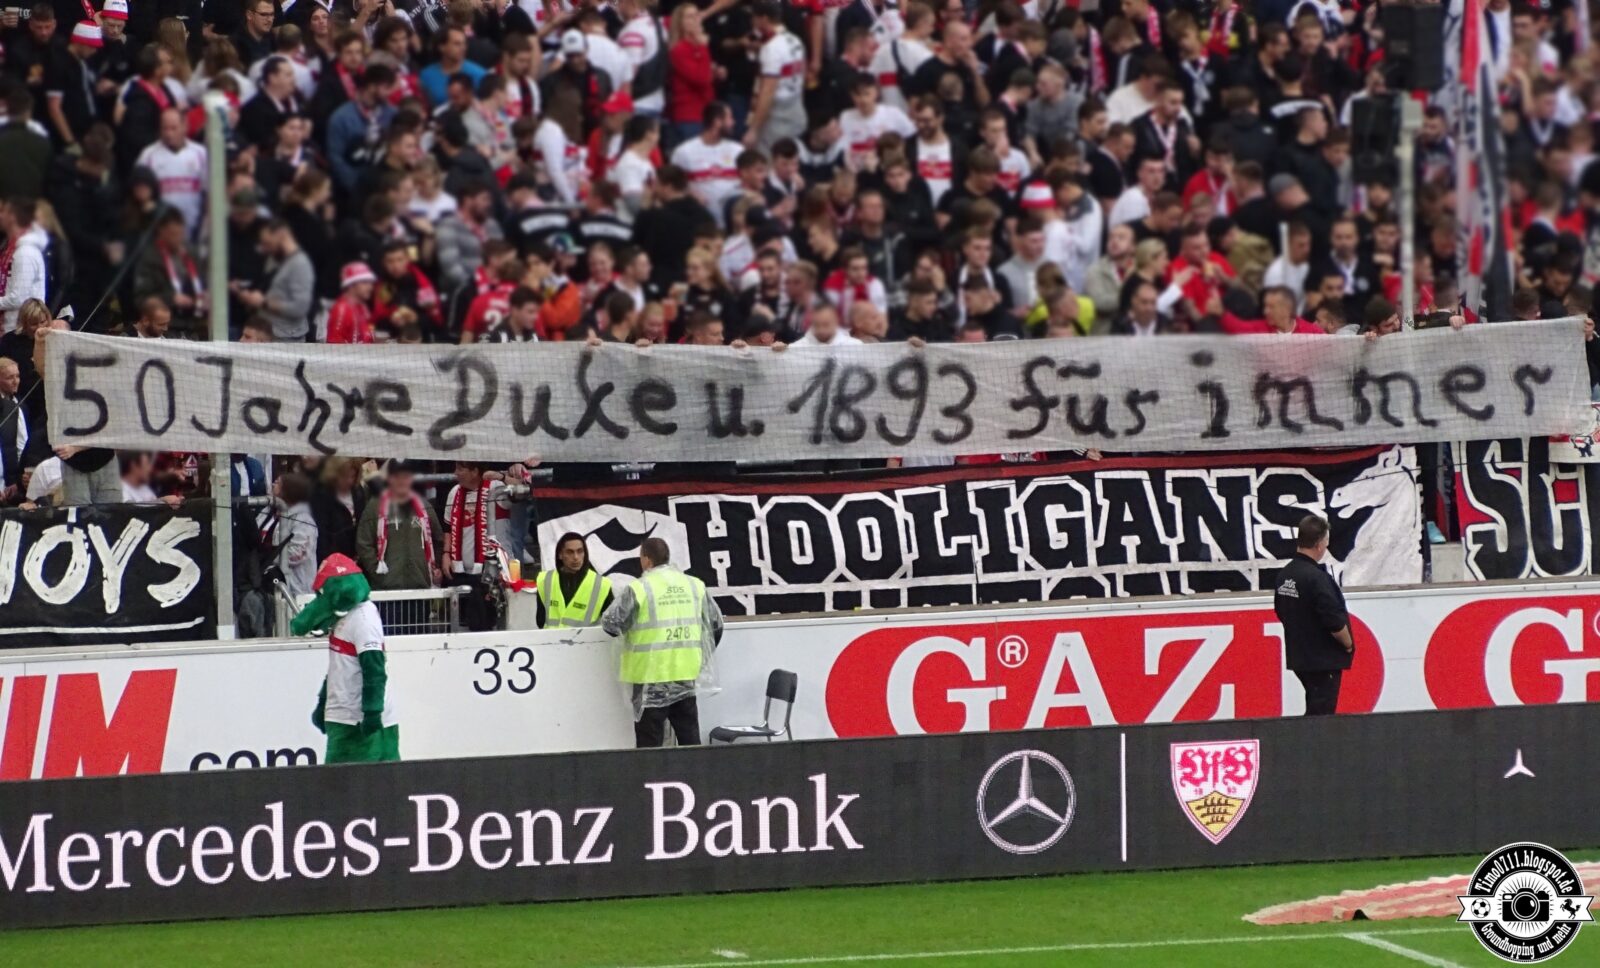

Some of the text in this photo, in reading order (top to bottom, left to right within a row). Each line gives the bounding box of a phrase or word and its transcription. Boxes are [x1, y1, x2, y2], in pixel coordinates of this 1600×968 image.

[63, 352, 177, 437] 50
[787, 355, 978, 445] 1893
[1006, 355, 1159, 440] für
[1190, 350, 1553, 439] immer
[669, 467, 1328, 588] HOOLIGANS
[666, 627, 690, 641] 2478
[473, 647, 536, 695] 33
[1178, 746, 1253, 789] VfB
[0, 774, 864, 892] Mercedes-Benz Bank
